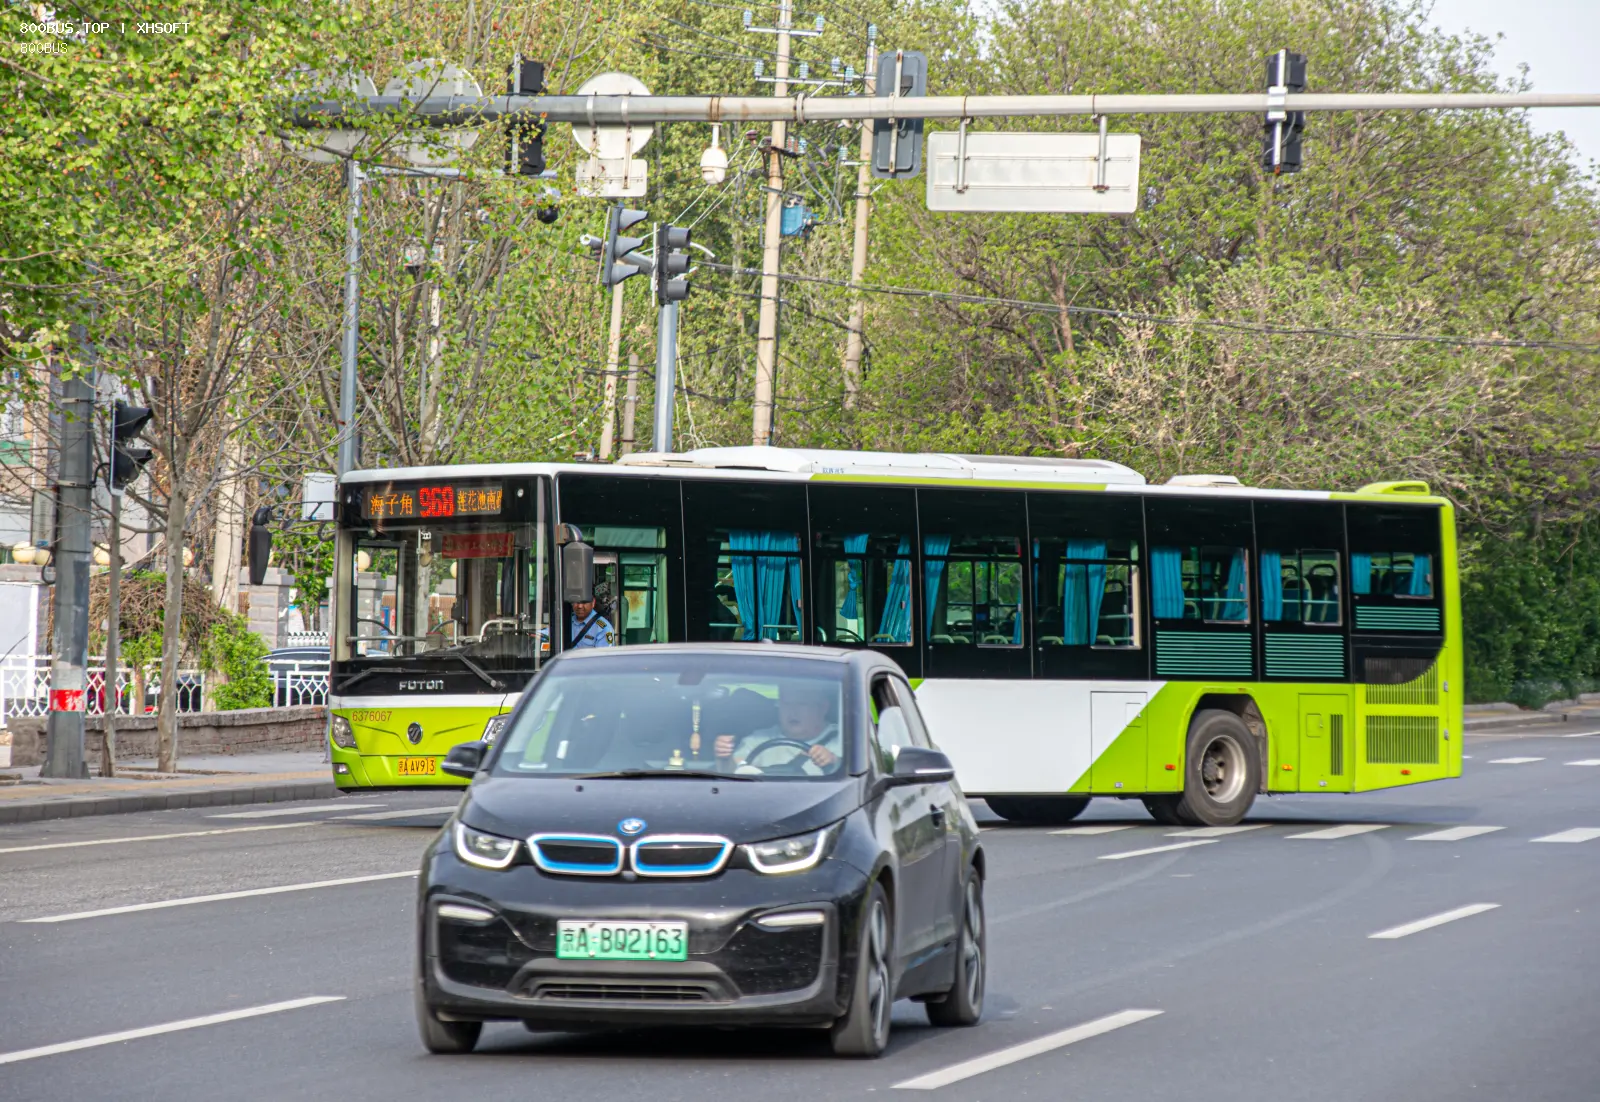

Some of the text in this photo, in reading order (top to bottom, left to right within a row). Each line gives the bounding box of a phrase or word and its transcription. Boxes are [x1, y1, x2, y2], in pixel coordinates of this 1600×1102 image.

[370, 493, 413, 516] 海子角
[419, 486, 455, 518] 968
[399, 680, 444, 691] FOTON
[352, 711, 392, 722] 6376067
